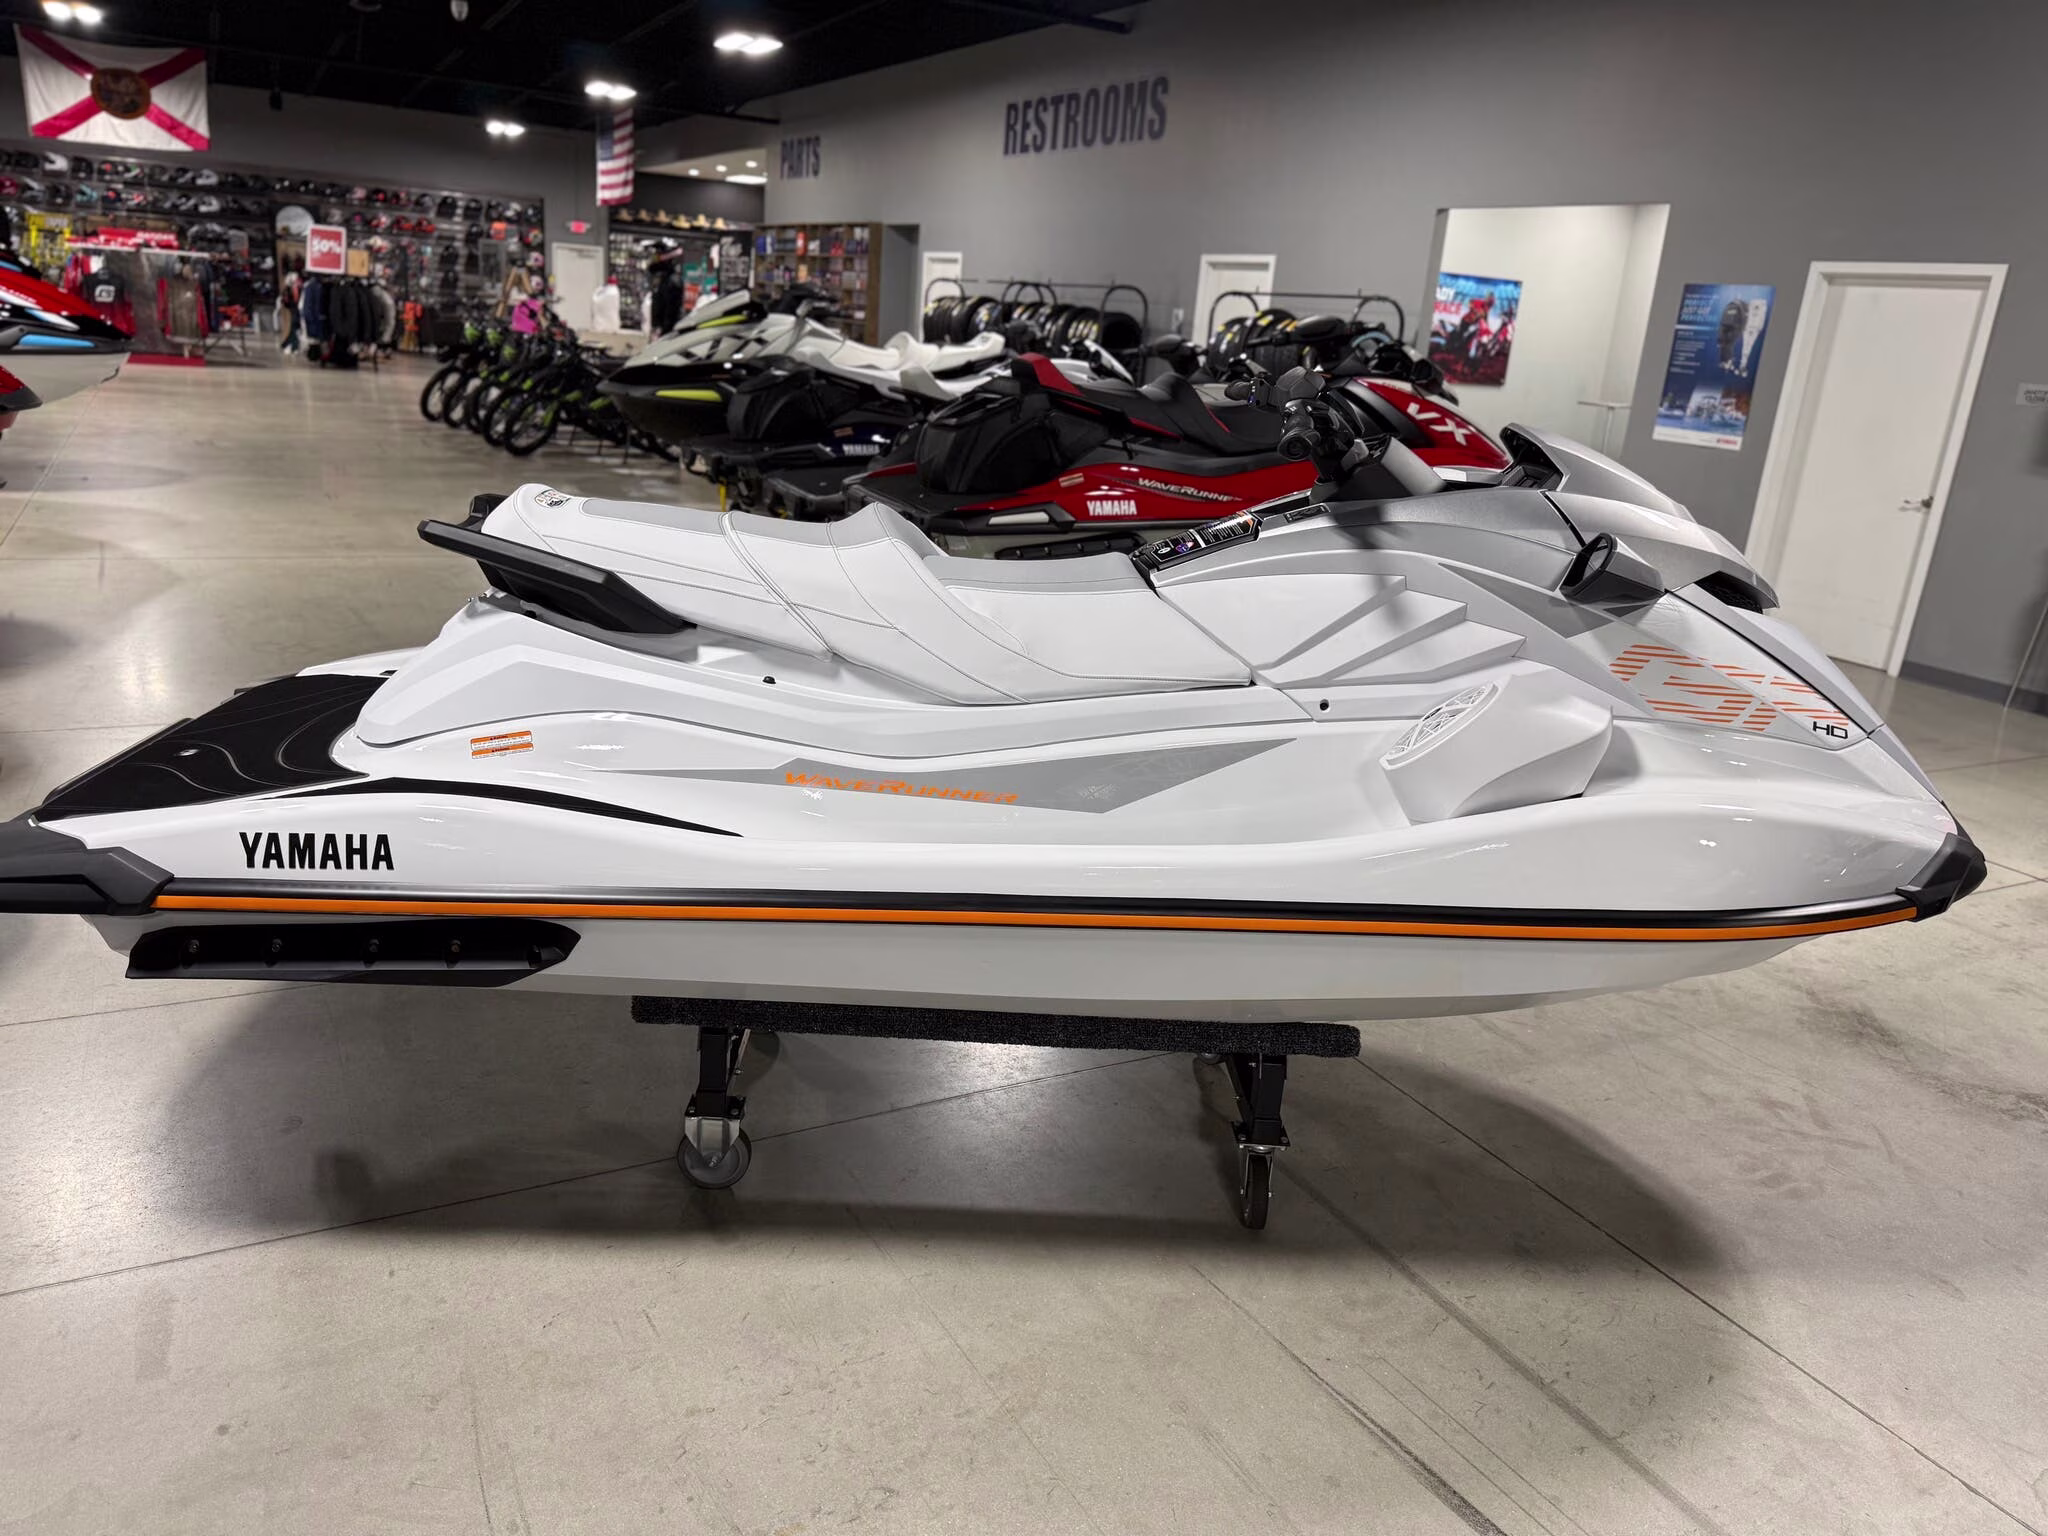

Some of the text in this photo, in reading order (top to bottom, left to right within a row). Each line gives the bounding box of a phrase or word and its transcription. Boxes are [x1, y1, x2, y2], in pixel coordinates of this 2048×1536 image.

[1003, 76, 1169, 155] RESTROOMS
[780, 136, 821, 179] PARTS
[312, 237, 341, 254] 50%
[1407, 402, 1472, 446] VX
[842, 444, 880, 456] YAMAHA
[1087, 500, 1138, 516] YAMAHA
[239, 832, 395, 871] YAMAHA
